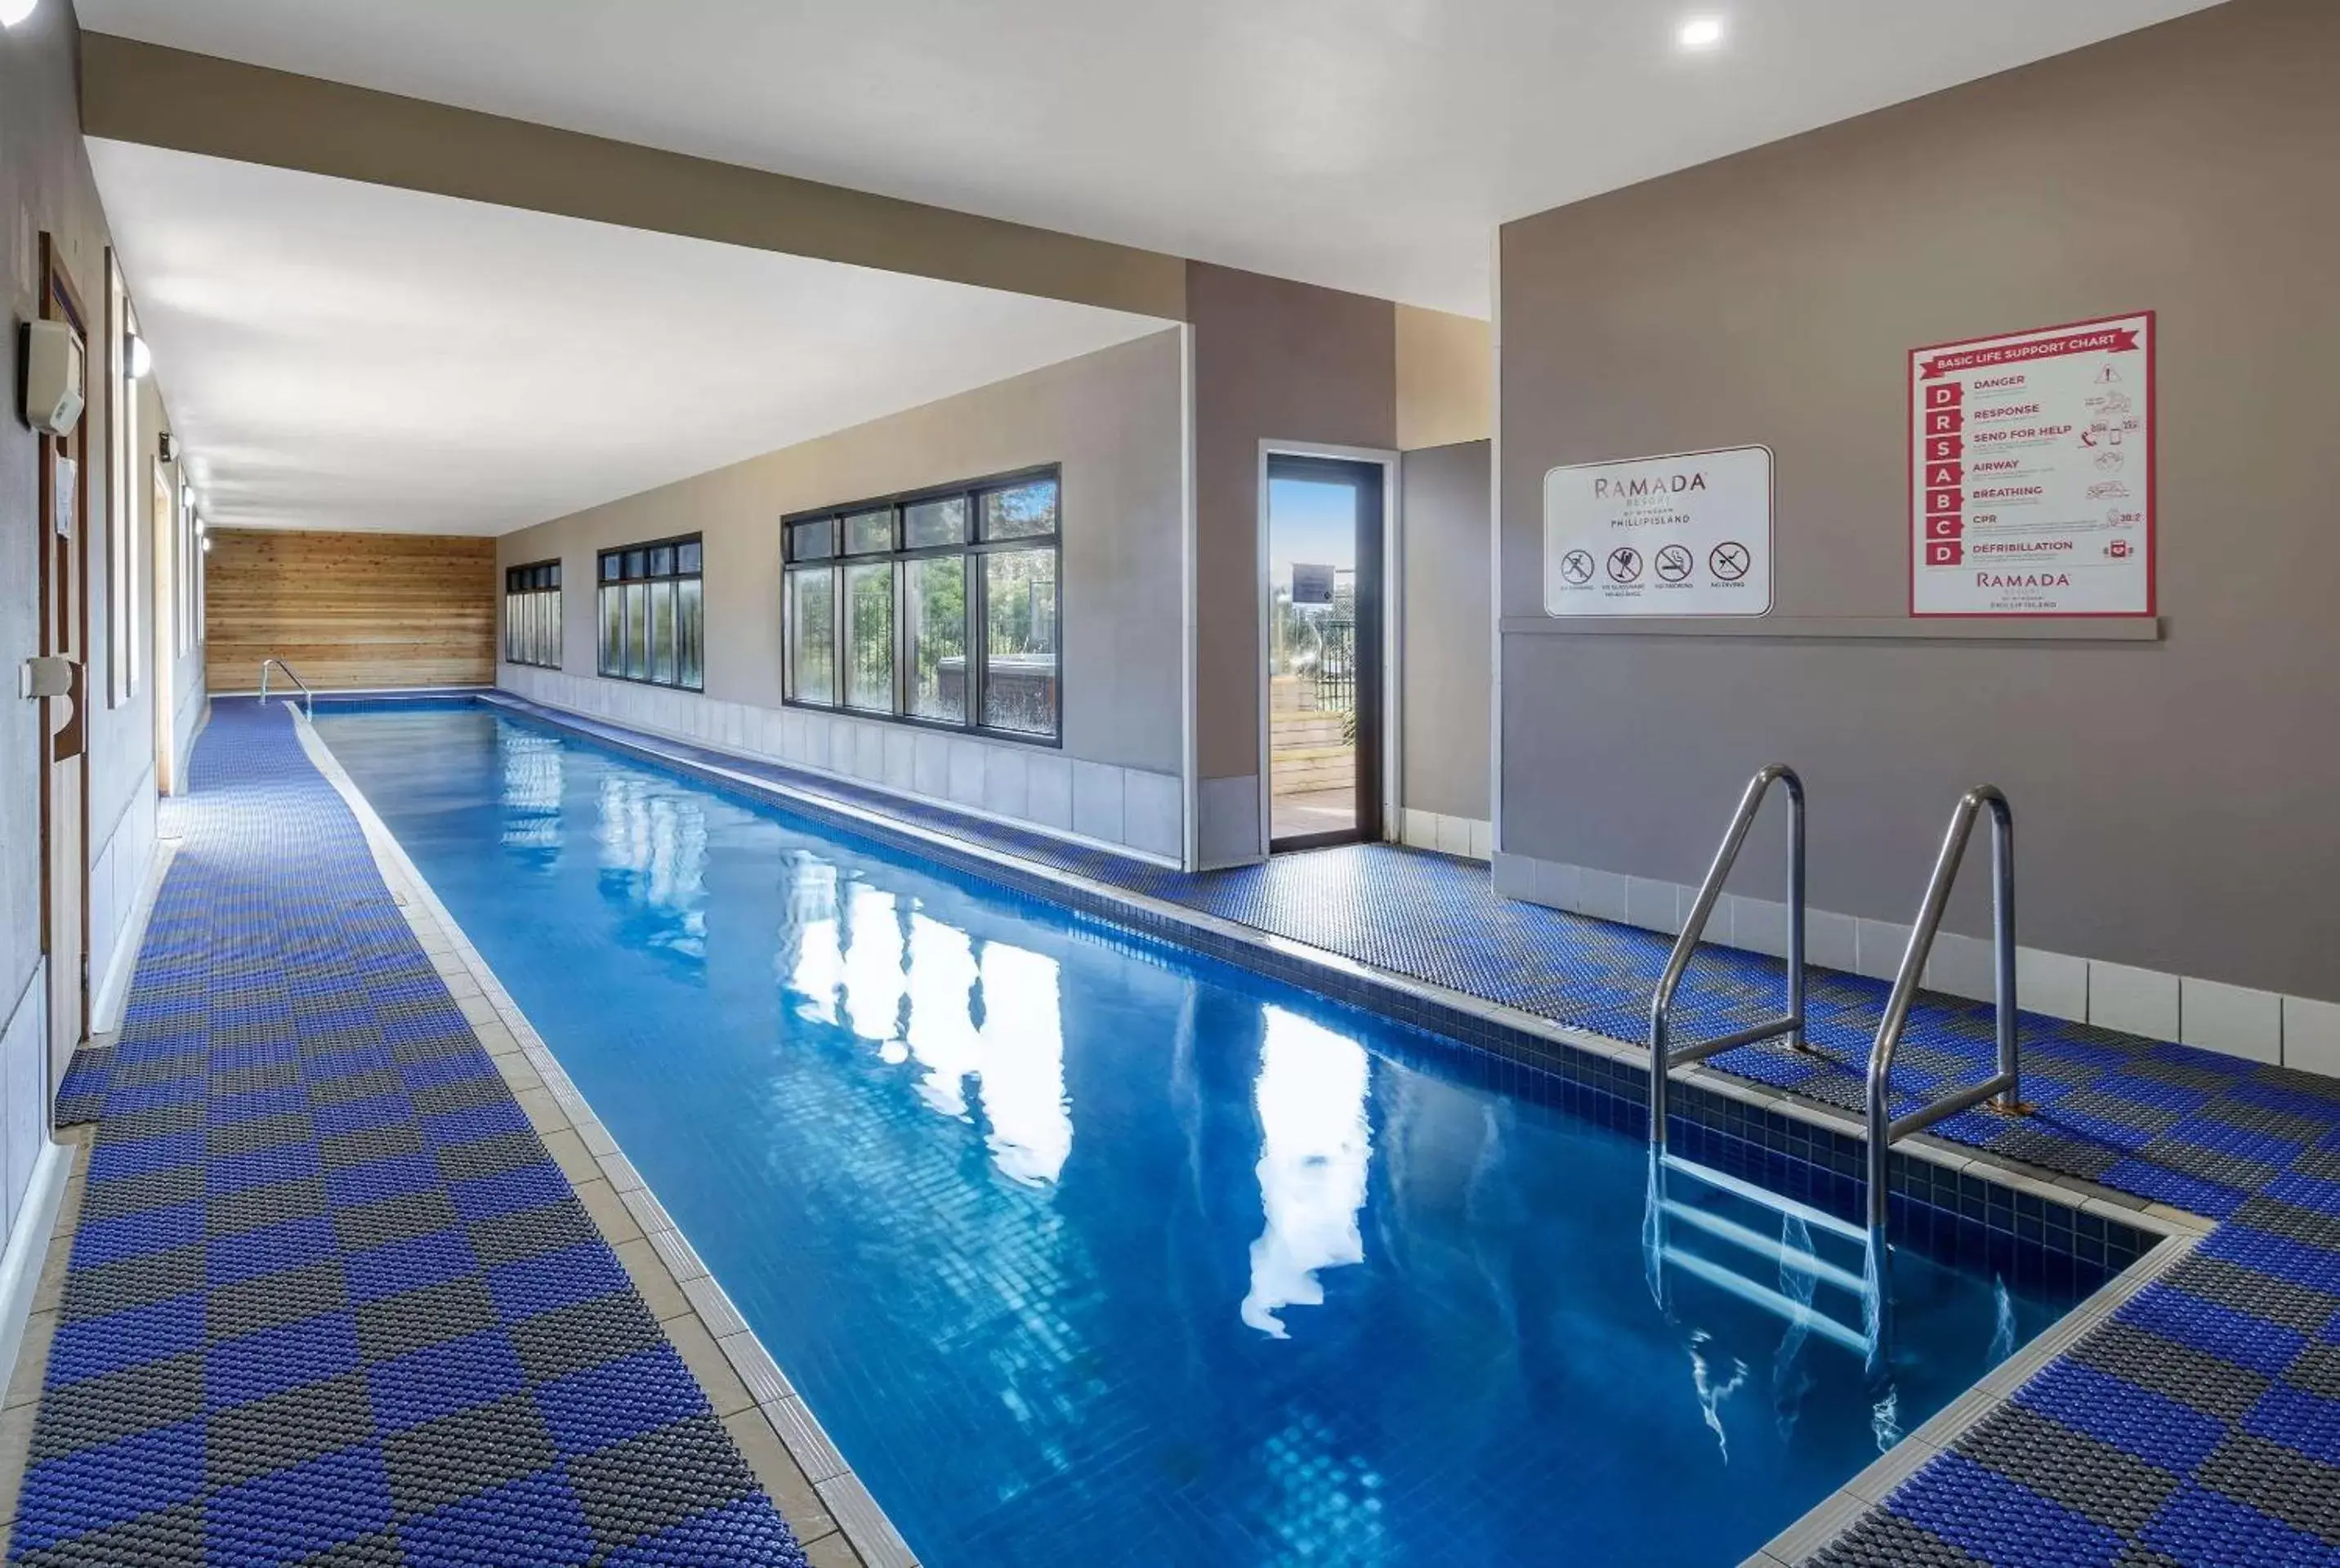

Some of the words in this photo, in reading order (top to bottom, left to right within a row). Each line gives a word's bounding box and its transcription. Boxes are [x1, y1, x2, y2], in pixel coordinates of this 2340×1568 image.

[1937, 355, 1972, 369] BASIC
[1976, 351, 2002, 363] LIFE
[2005, 341, 2066, 359] SUPPORT
[2070, 334, 2115, 349] CHART
[1974, 375, 2025, 389] DANGER
[1936, 390, 1951, 404] D
[1974, 404, 2040, 419] RESPONSE
[1936, 416, 1950, 431] R
[1973, 431, 2007, 443] SEND
[2010, 428, 2035, 439] FOR
[2039, 425, 2072, 436] HELP
[1937, 441, 1949, 456] S
[1973, 460, 2020, 471] AIRWAY
[1935, 468, 1951, 483] A
[1595, 472, 1706, 499] RAMADA
[1973, 486, 2043, 499] BREATHING
[1936, 494, 1950, 508] B
[1973, 515, 1997, 524] CPR
[1936, 520, 1950, 534] C
[1936, 547, 1951, 561] D
[1976, 572, 2070, 587] RAMADA
